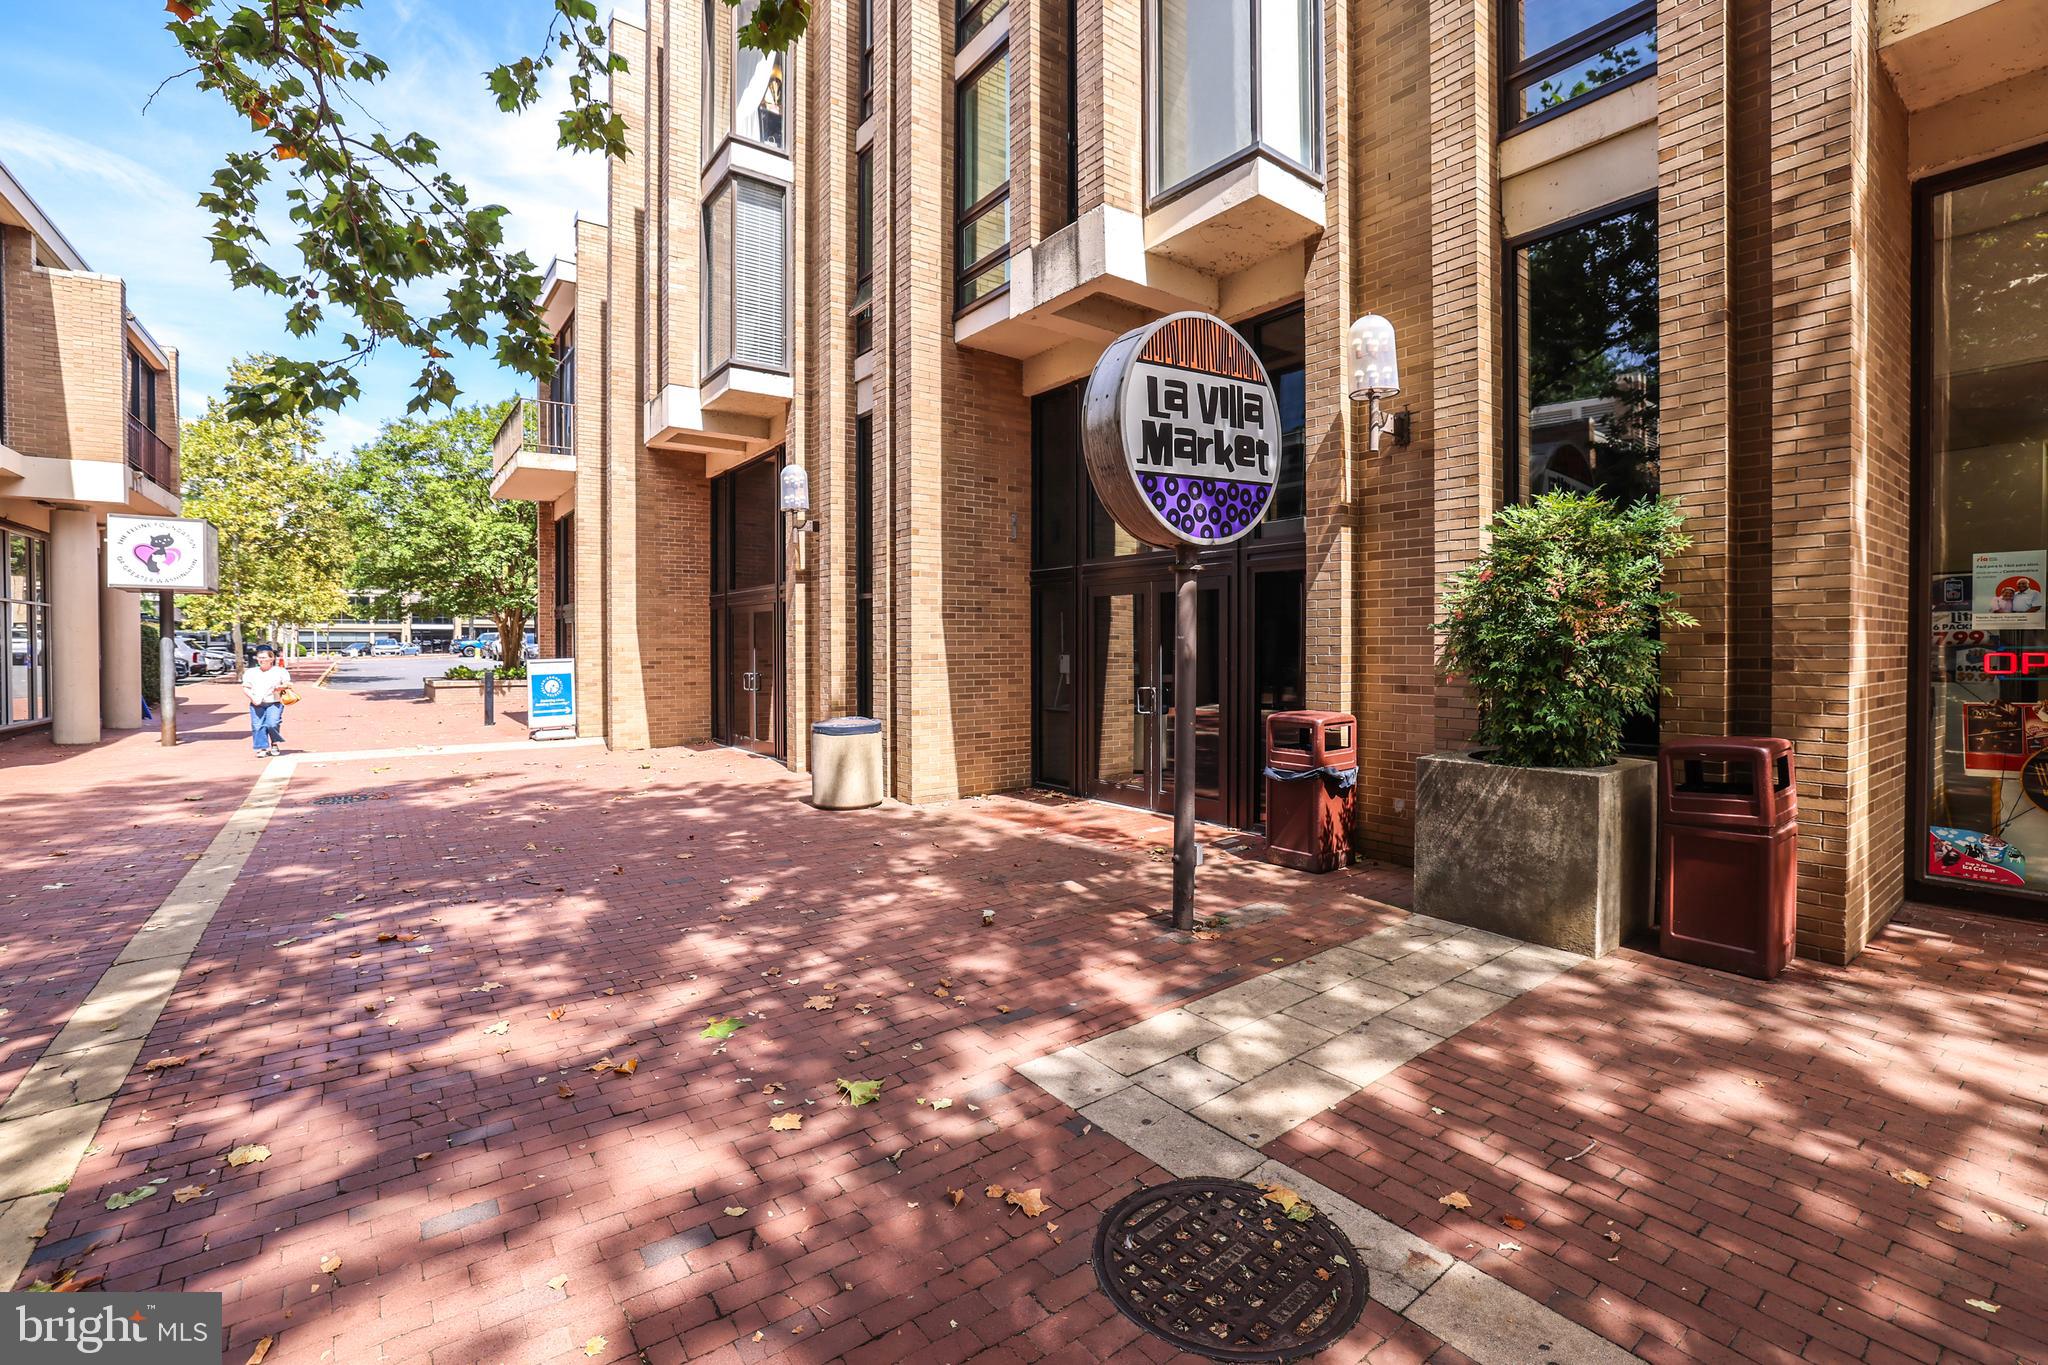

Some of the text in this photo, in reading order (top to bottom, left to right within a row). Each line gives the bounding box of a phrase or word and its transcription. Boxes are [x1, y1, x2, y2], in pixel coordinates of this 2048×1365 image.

[1146, 375, 1264, 430] La Villa
[1136, 419, 1270, 476] Market
